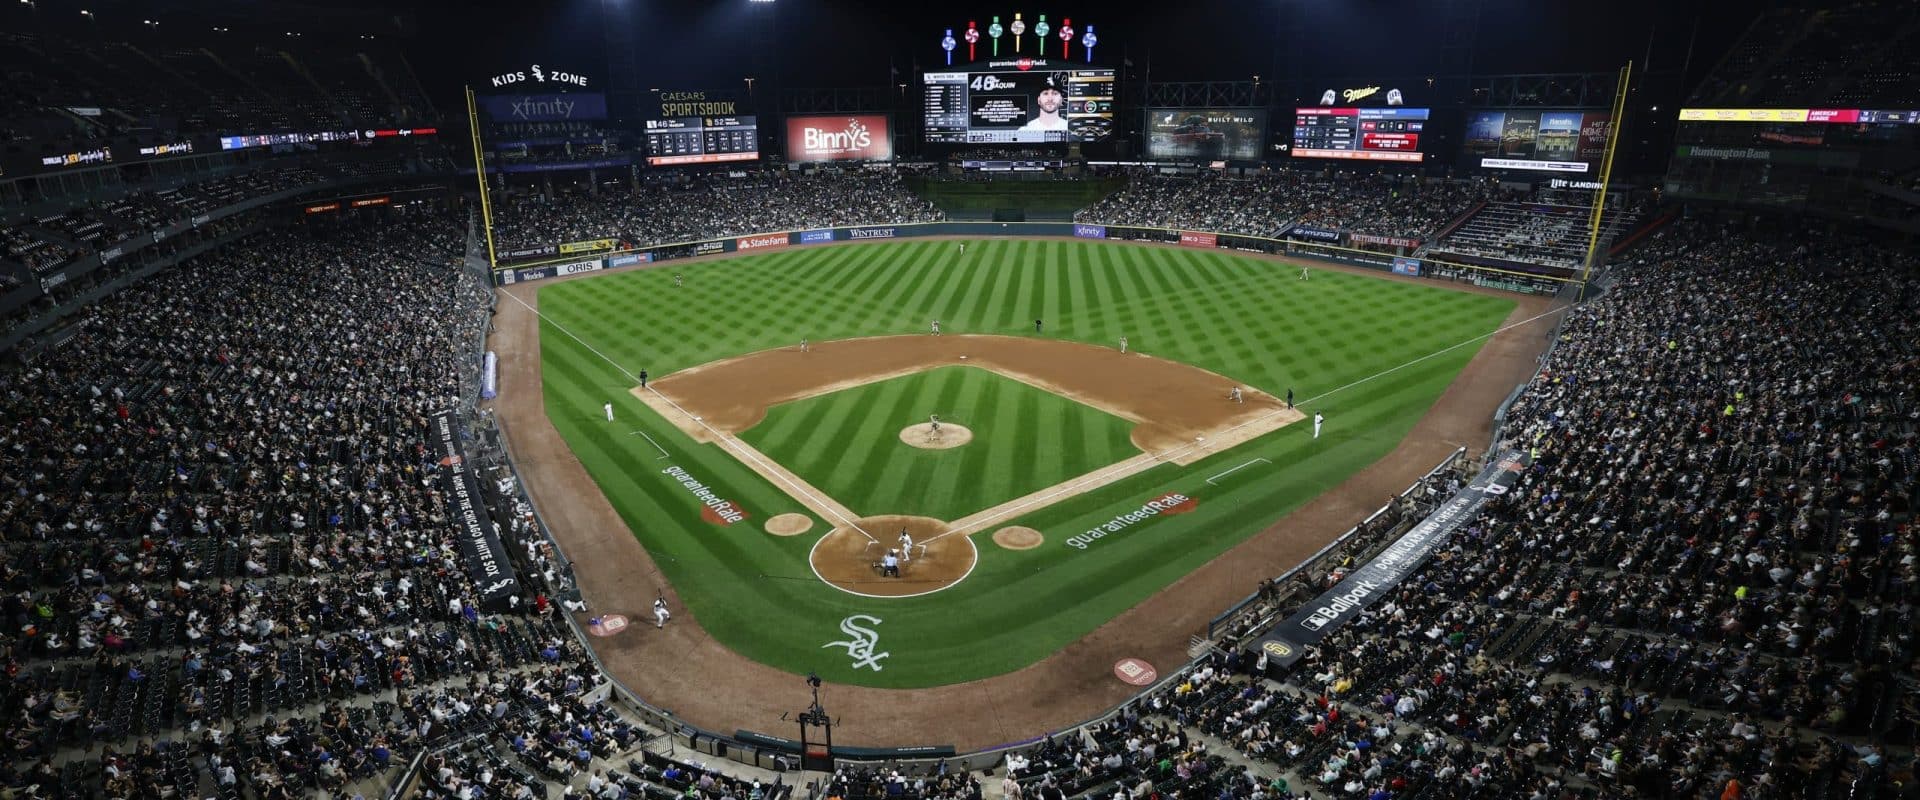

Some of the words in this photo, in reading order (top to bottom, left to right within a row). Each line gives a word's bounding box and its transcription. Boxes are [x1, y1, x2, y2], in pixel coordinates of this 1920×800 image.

[491, 71, 526, 87] KIDS
[551, 71, 588, 86] ZONE
[661, 92, 706, 101] CAESARS
[511, 97, 574, 120] xfinity
[661, 102, 736, 116] SPORTSBOOK
[1690, 146, 1746, 159] Huntington
[1746, 148, 1770, 159] Bank
[849, 228, 895, 237] WINTRUST
[1078, 225, 1100, 236] xfinity
[567, 262, 593, 273] ORIS
[523, 270, 545, 281] Modelo
[459, 498, 473, 511] THE
[463, 509, 483, 538] CHICAGO
[474, 537, 493, 560] WHITE
[483, 560, 500, 577] SOX
[1316, 580, 1380, 619] Ballpark
[1375, 534, 1424, 570] DOWNLOAD
